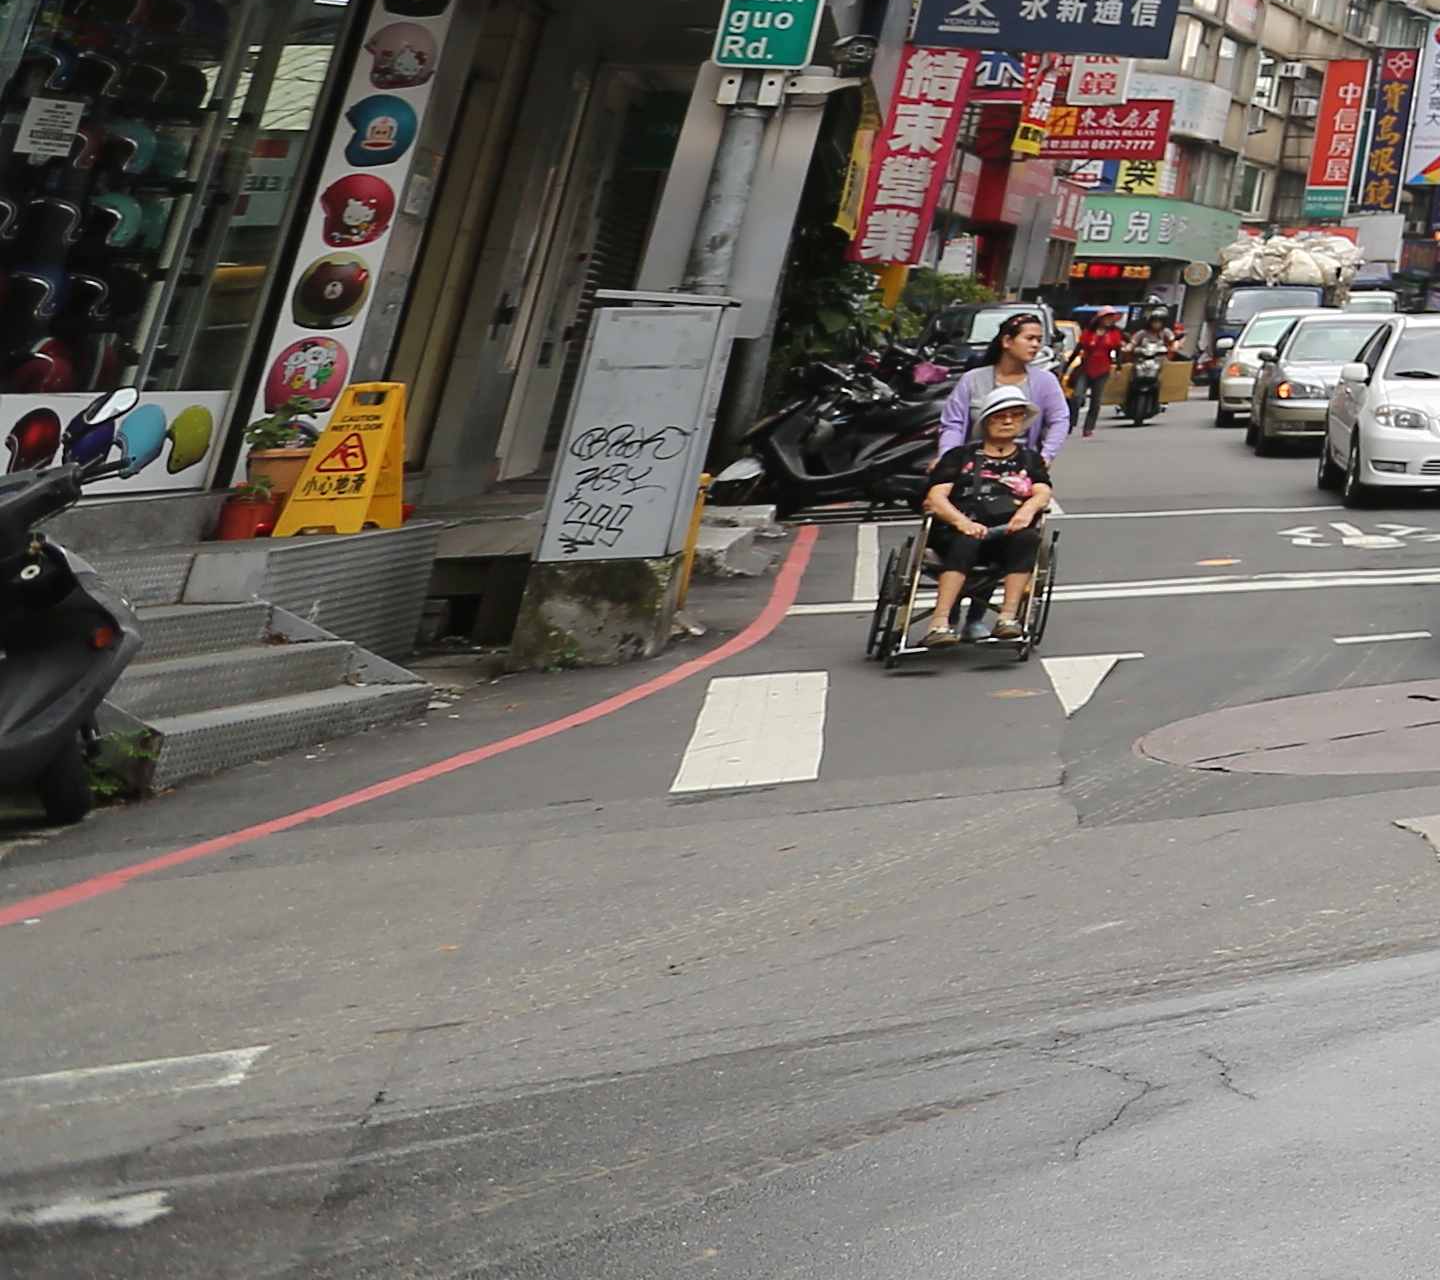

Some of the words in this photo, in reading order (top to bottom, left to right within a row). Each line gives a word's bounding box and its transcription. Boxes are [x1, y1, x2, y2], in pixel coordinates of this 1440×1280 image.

[728, 9, 794, 33] guo
[720, 36, 774, 61] Rd.
[1323, 82, 1363, 182] 中信房屋
[860, 48, 968, 264] 結束營業
[1364, 80, 1410, 210] 寶島眼鏡
[330, 423, 350, 432] WET
[351, 422, 384, 432] FLOOR
[340, 414, 382, 424] CAUTION
[301, 472, 367, 496] 小心地滑
